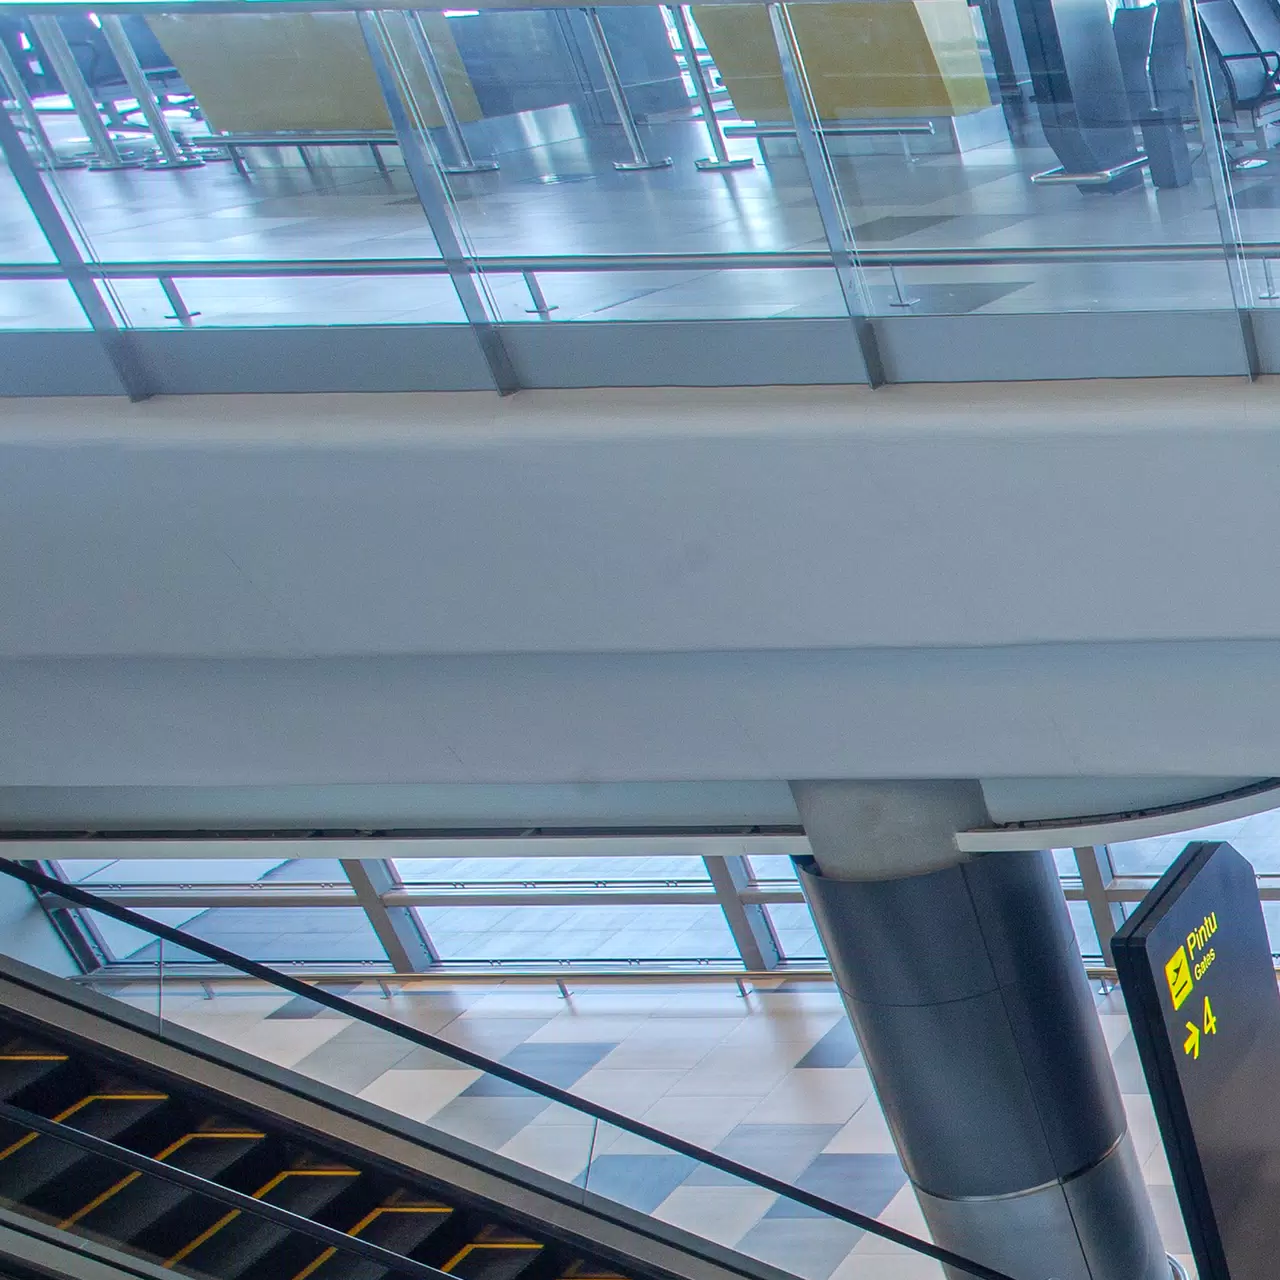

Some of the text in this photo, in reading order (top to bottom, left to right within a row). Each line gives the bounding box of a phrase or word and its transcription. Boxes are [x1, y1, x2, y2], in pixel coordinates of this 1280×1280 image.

[1186, 911, 1218, 961] Pintu
[1194, 948, 1216, 981] Gates
[1203, 995, 1217, 1035] 4
